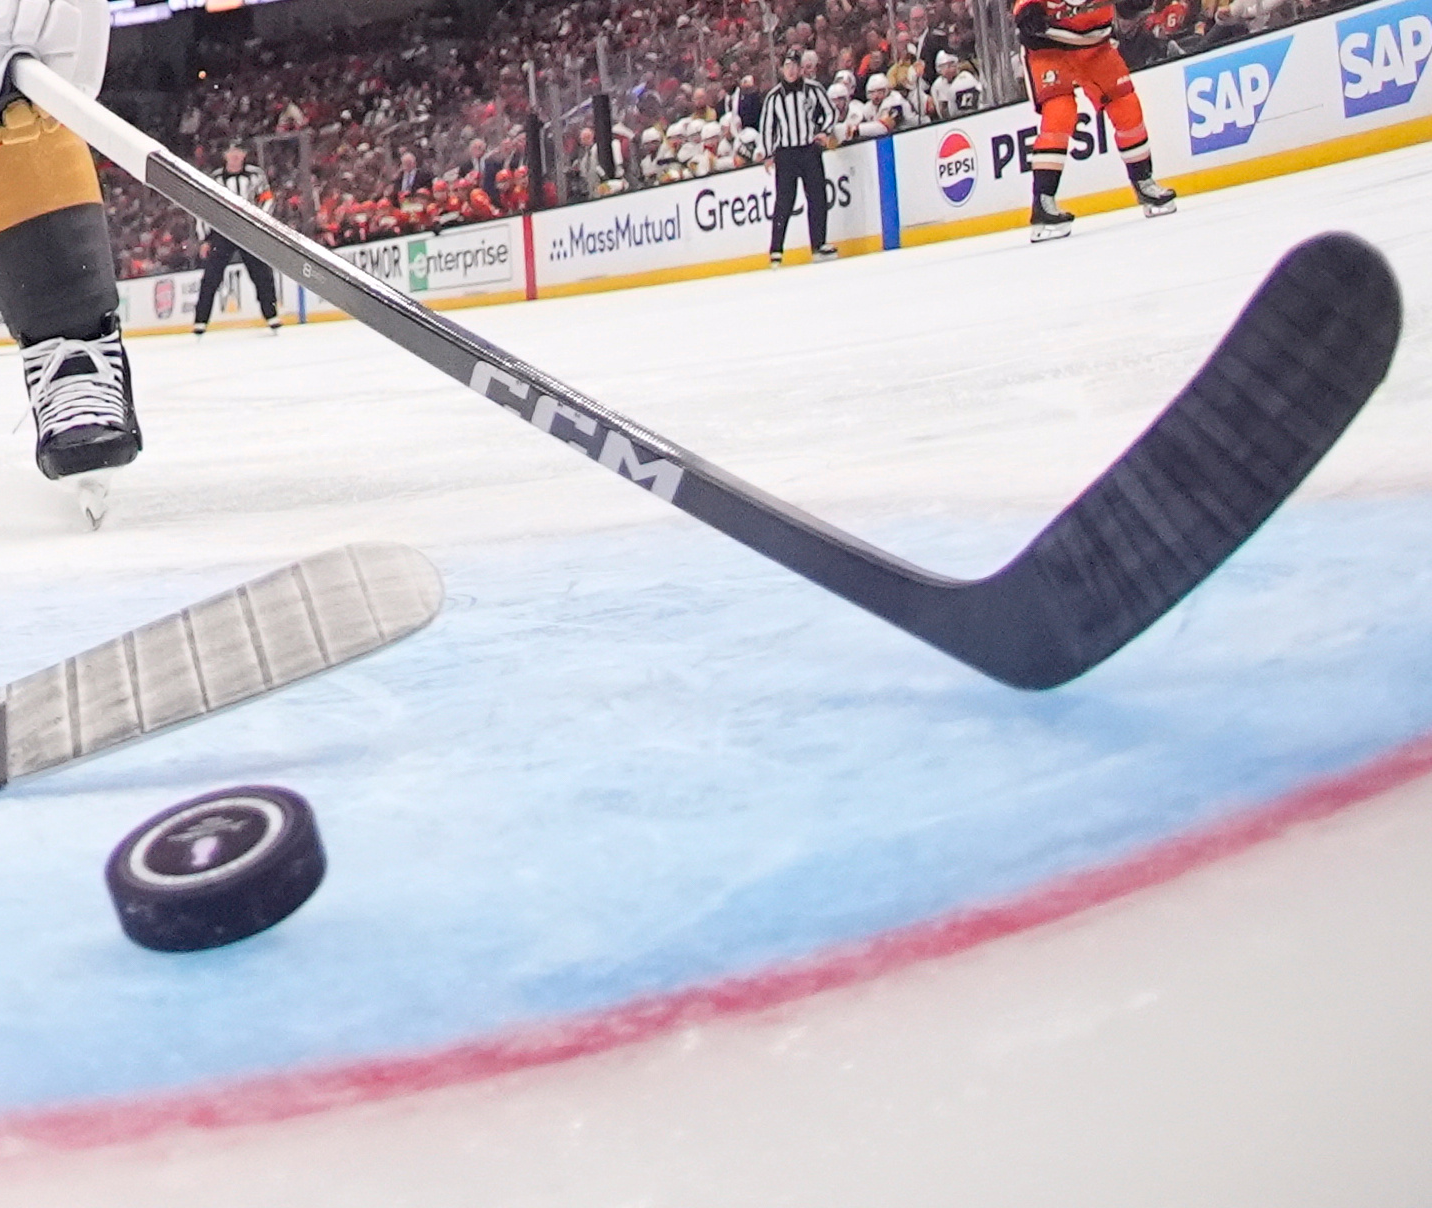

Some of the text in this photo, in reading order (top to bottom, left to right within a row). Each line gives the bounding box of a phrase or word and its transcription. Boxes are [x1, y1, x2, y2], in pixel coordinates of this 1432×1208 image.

[1338, 14, 1432, 100] SAP
[1186, 63, 1271, 139] SAP
[938, 158, 975, 179] PEPSI
[990, 107, 1109, 180] PESI
[568, 203, 681, 258] MassMutual
[694, 184, 774, 232] Great
[409, 239, 509, 279] enterprise
[469, 360, 685, 505] CCM
